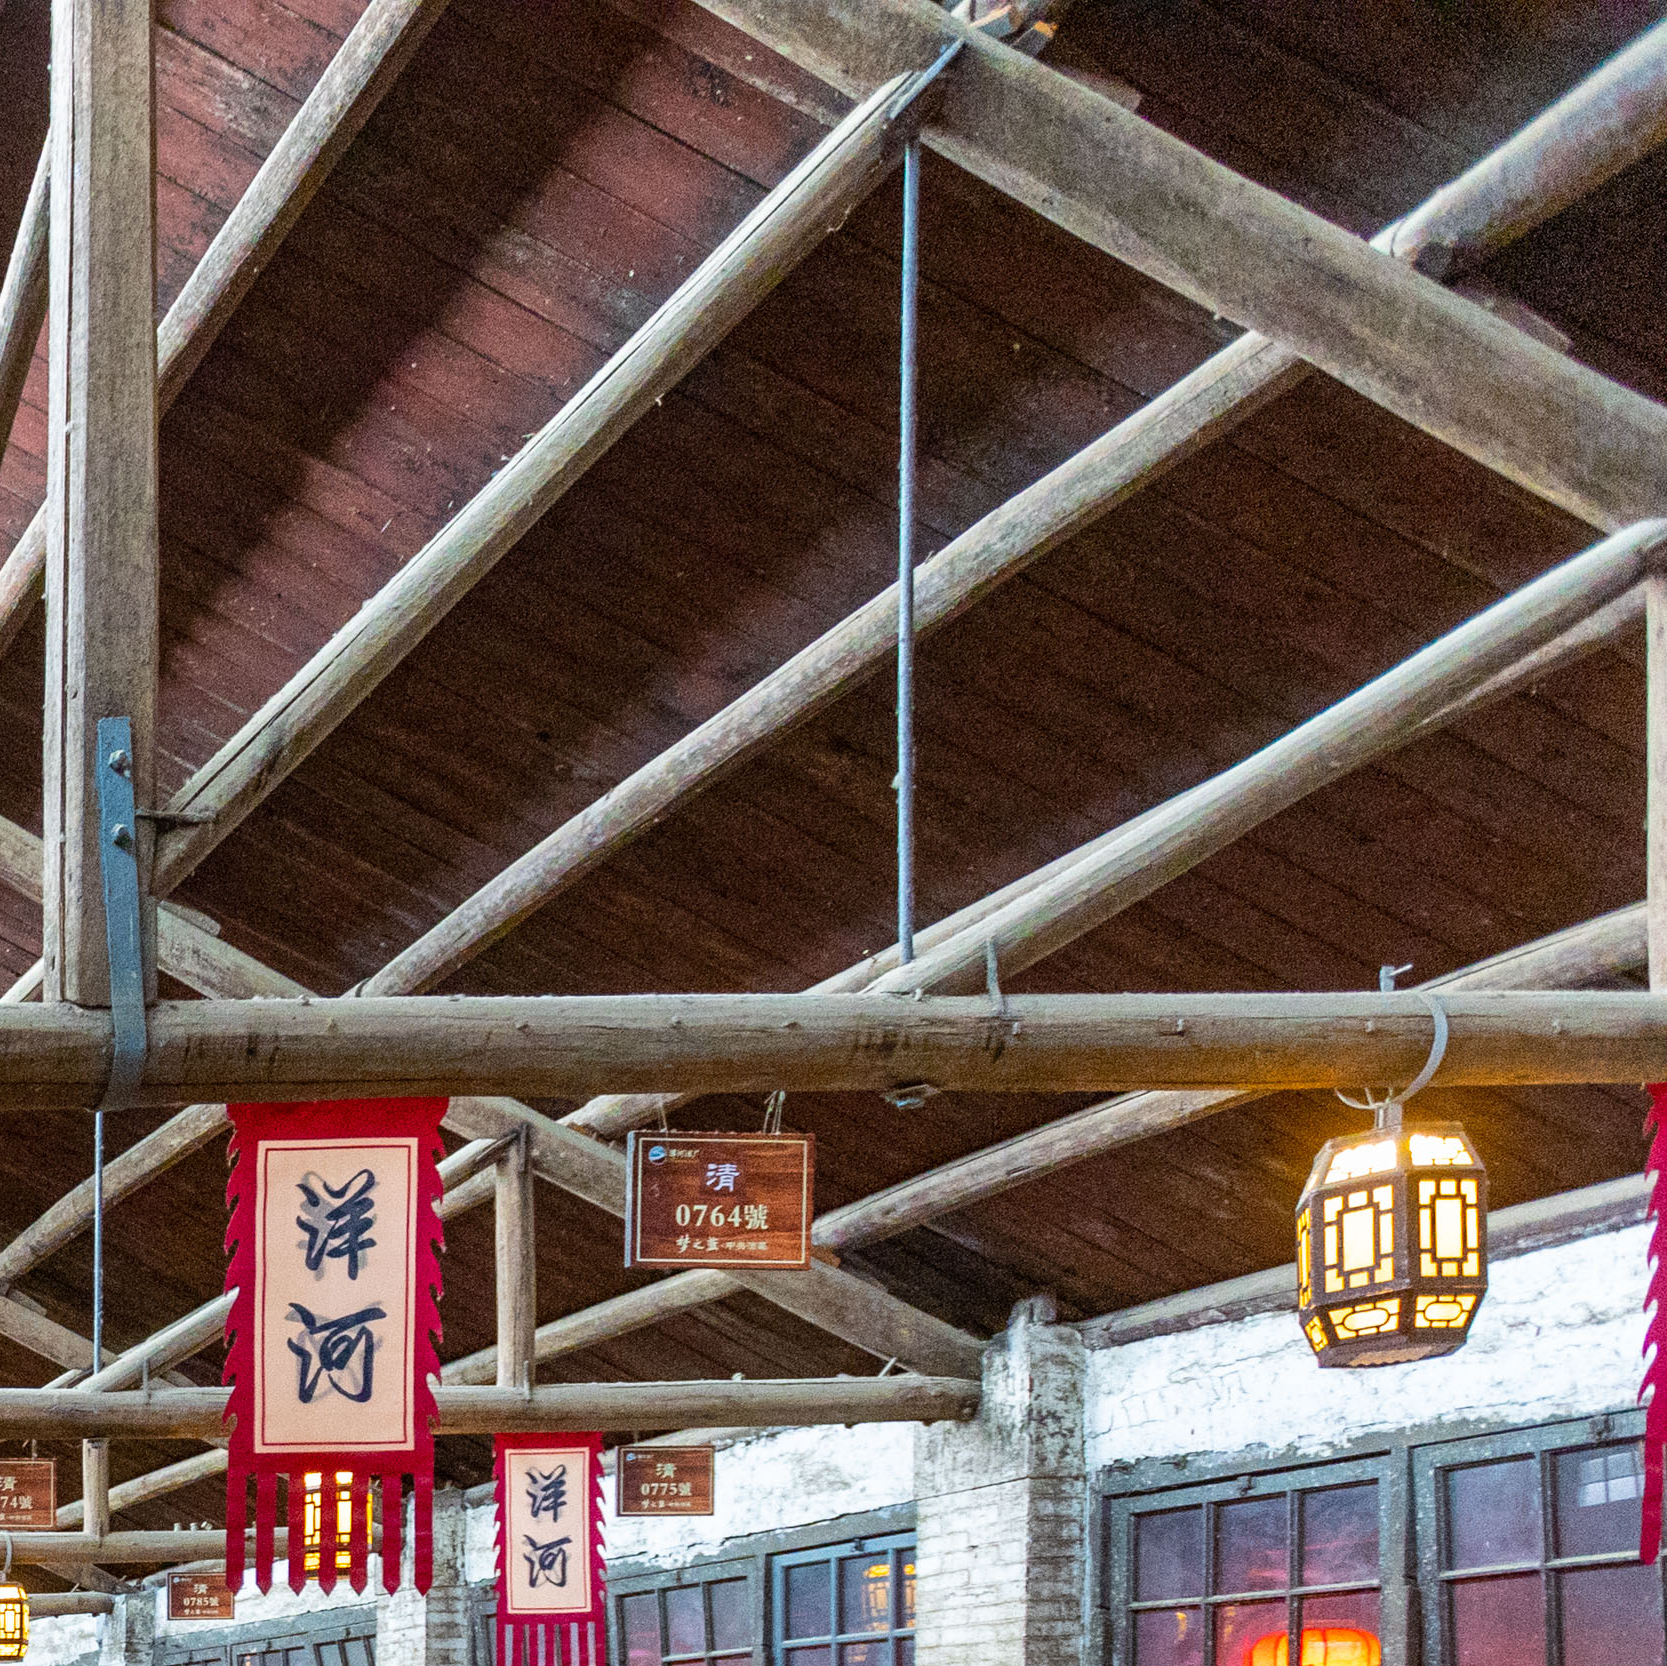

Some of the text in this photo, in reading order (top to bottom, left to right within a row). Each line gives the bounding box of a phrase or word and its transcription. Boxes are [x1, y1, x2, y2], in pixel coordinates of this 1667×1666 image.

[706, 1163, 740, 1192] 清
[675, 1203, 769, 1230] 0764號
[285, 1168, 387, 1404] 洋河
[640, 1482, 692, 1496] 0775號
[523, 1464, 573, 1589] 洋河
